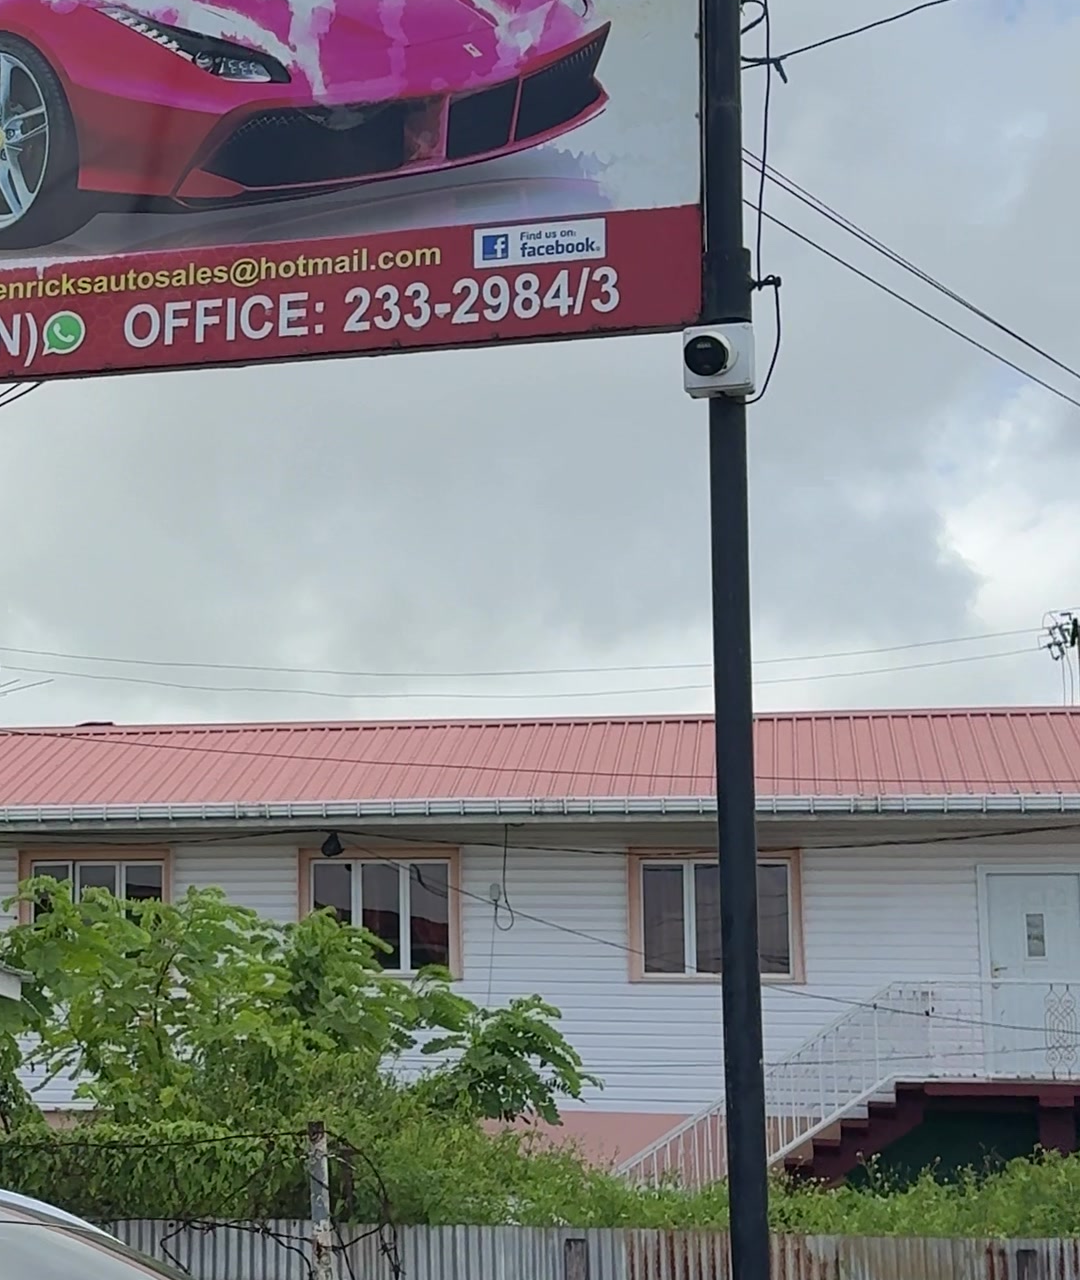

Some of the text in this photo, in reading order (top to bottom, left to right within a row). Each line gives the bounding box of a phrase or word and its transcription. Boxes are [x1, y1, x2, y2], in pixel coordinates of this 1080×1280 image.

[519, 230, 543, 241] Find
[545, 229, 557, 239] us
[122, 267, 621, 350] OFFICE: 233-2984/3
